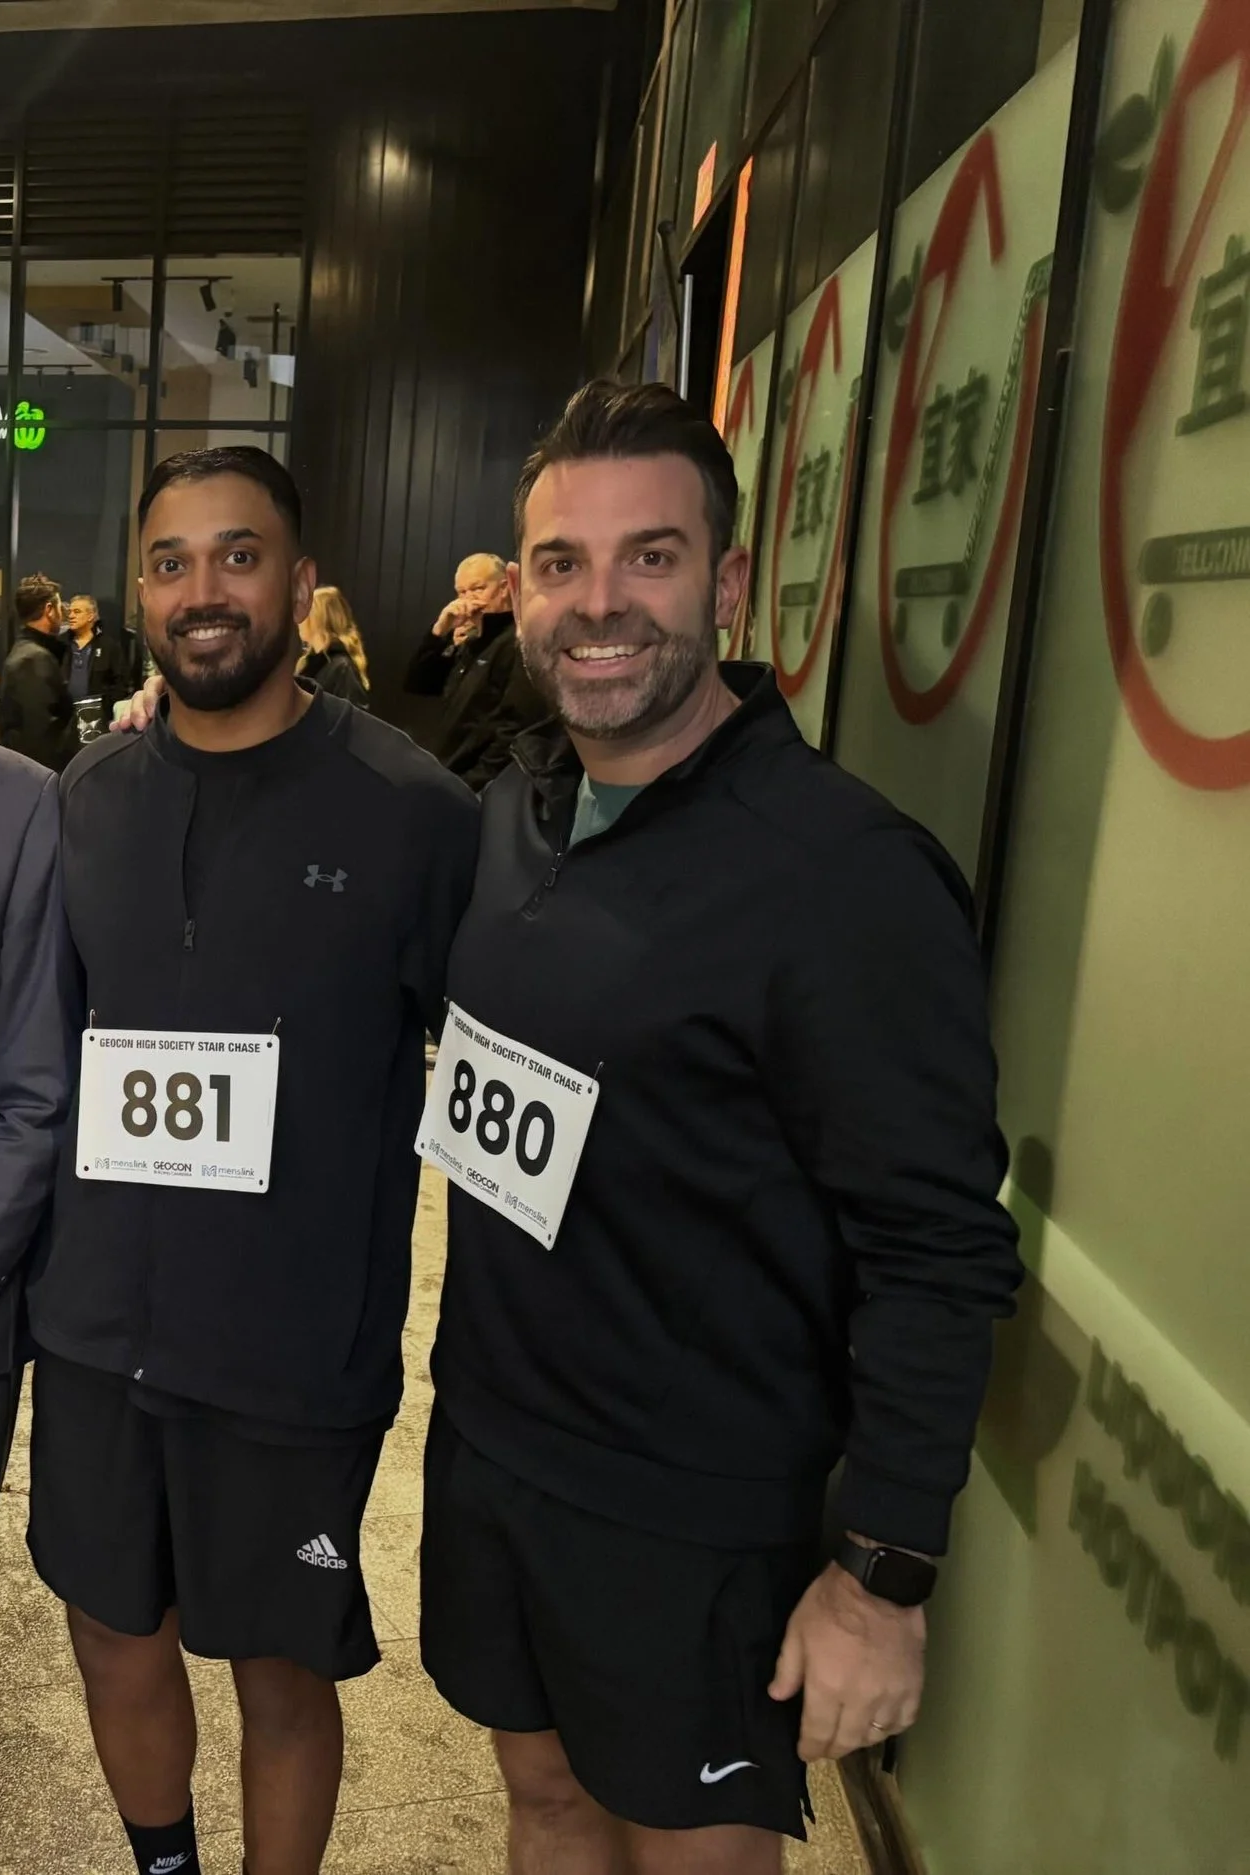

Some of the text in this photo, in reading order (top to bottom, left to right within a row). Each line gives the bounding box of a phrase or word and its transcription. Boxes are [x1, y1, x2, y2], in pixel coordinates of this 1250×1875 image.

[100, 1038, 261, 1053] GEOCON HIGH SOCIETY STAIR CHASE
[454, 1016, 582, 1095] GEOCON HIGH SOCIETY STAIR CHASE
[121, 1069, 231, 1143] 881
[448, 1058, 555, 1177] 880
[153, 1161, 192, 1172] GEOCON
[467, 1167, 500, 1193] GEOCON
[296, 1549, 348, 1569] adidas
[155, 1851, 186, 1868] NIKE
